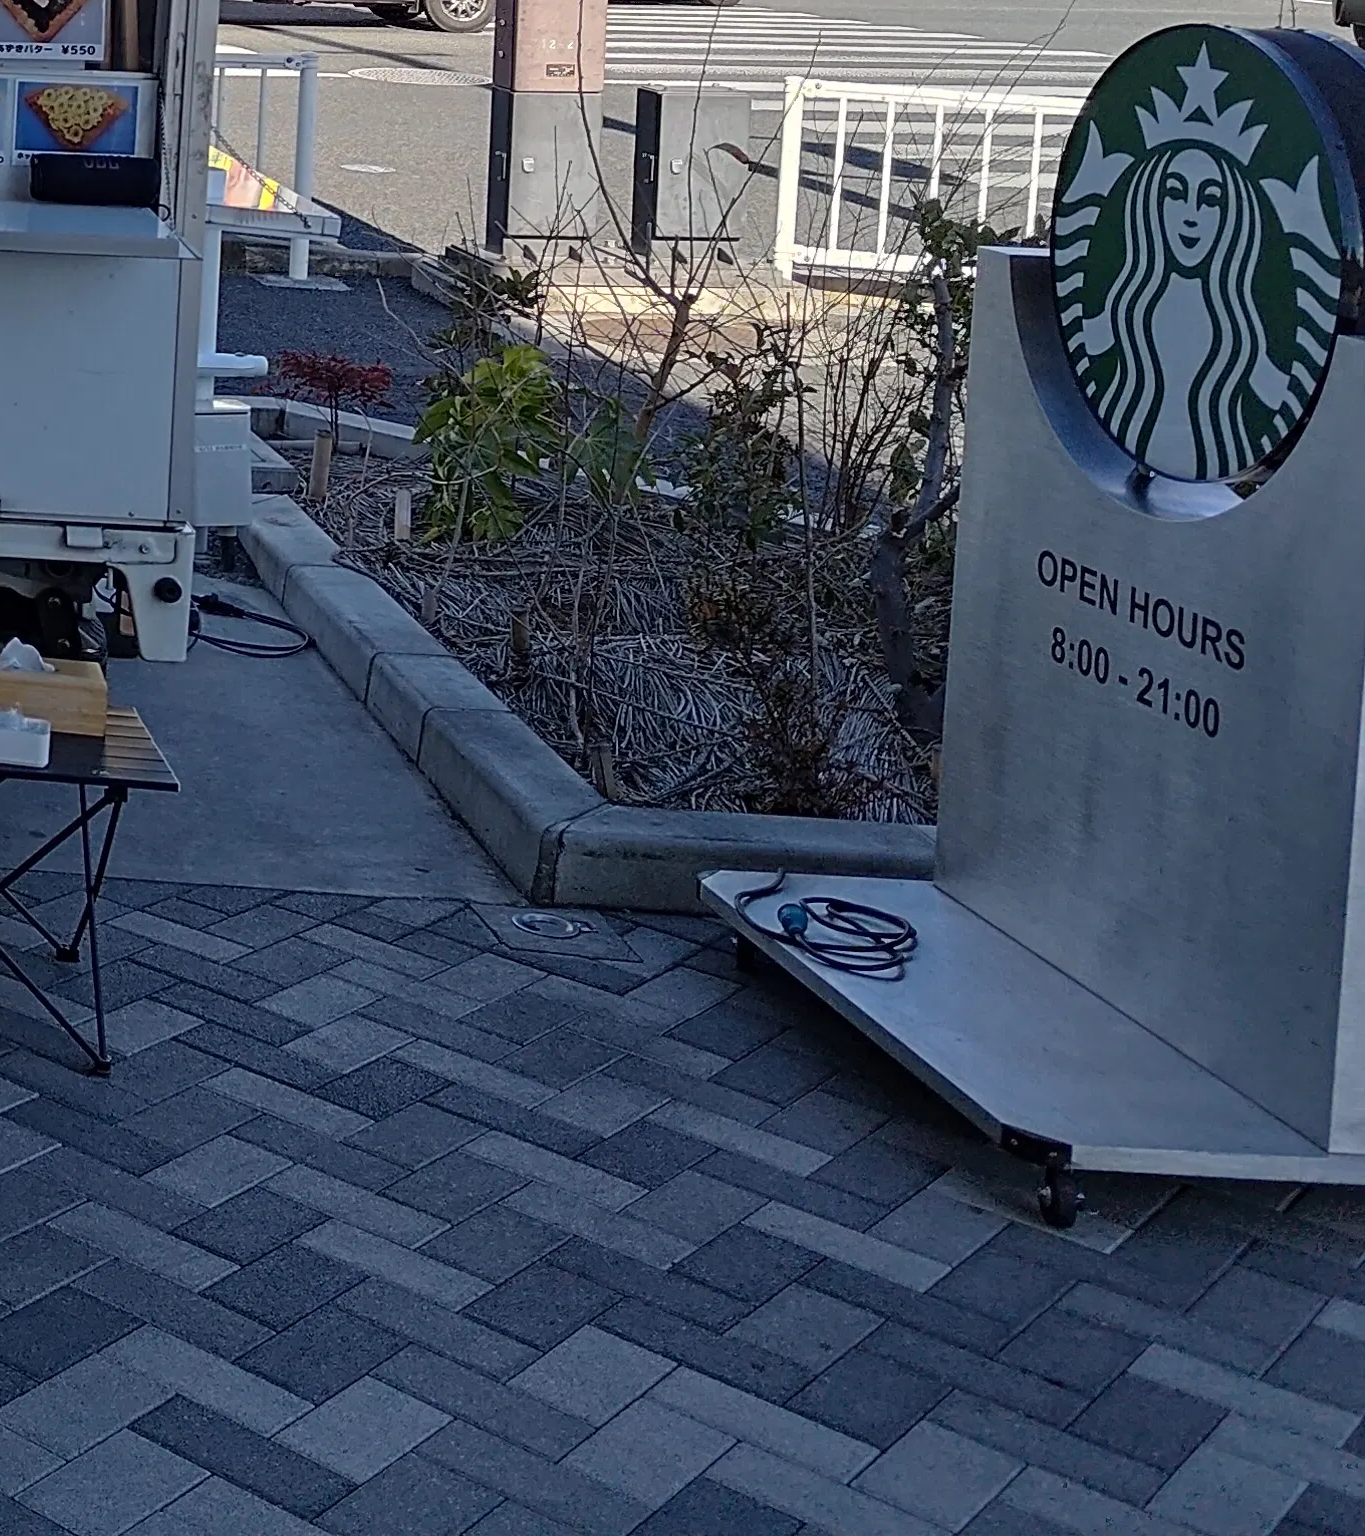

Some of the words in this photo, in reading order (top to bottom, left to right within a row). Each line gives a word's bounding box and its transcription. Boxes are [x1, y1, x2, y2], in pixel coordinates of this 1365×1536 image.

[61, 44, 96, 55] ¥550
[1037, 550, 1119, 616] OPEN
[1129, 586, 1245, 671] HOURS
[1050, 626, 1110, 685] 8:00
[1136, 667, 1220, 738] 21:00
